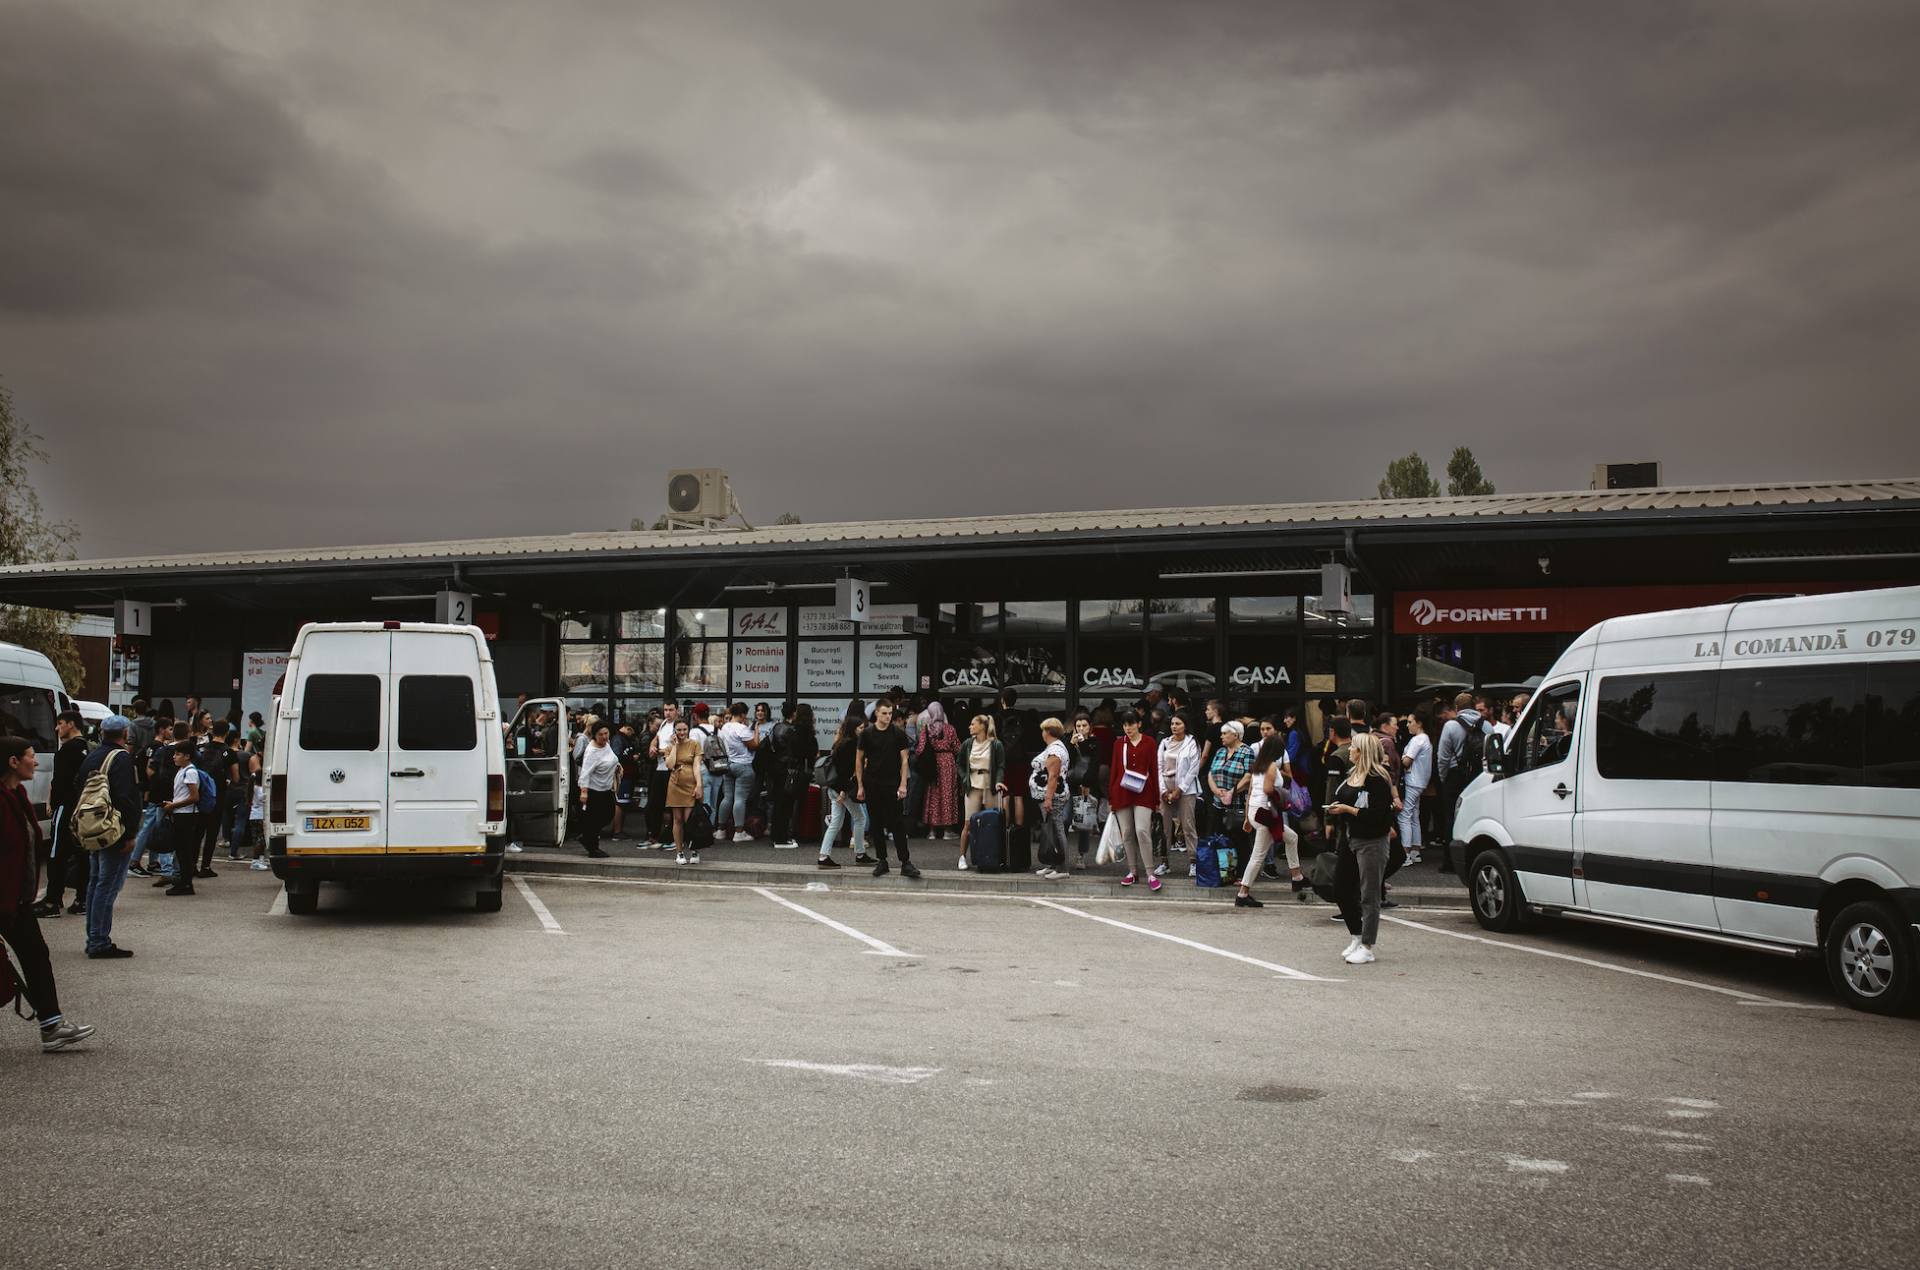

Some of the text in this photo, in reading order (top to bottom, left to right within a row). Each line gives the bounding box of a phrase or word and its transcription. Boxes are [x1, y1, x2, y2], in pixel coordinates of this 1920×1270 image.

[856, 590, 864, 612] 3
[134, 608, 139, 627] 1
[456, 600, 464, 622] 2
[1436, 608, 1548, 622] FORNETTI
[740, 612, 778, 634] GAL
[862, 621, 904, 632] www.galtrans
[1694, 642, 1720, 657] LA
[1866, 628, 1916, 647] 079
[248, 656, 265, 664] Treci
[276, 656, 288, 664] Ora
[746, 647, 784, 656] România
[745, 664, 779, 672] Ucraina
[1083, 668, 1137, 685] CASA
[1233, 666, 1291, 684] CASA
[745, 680, 769, 689] Rusia
[942, 668, 993, 686] CASA
[315, 818, 364, 829] IZX 052
